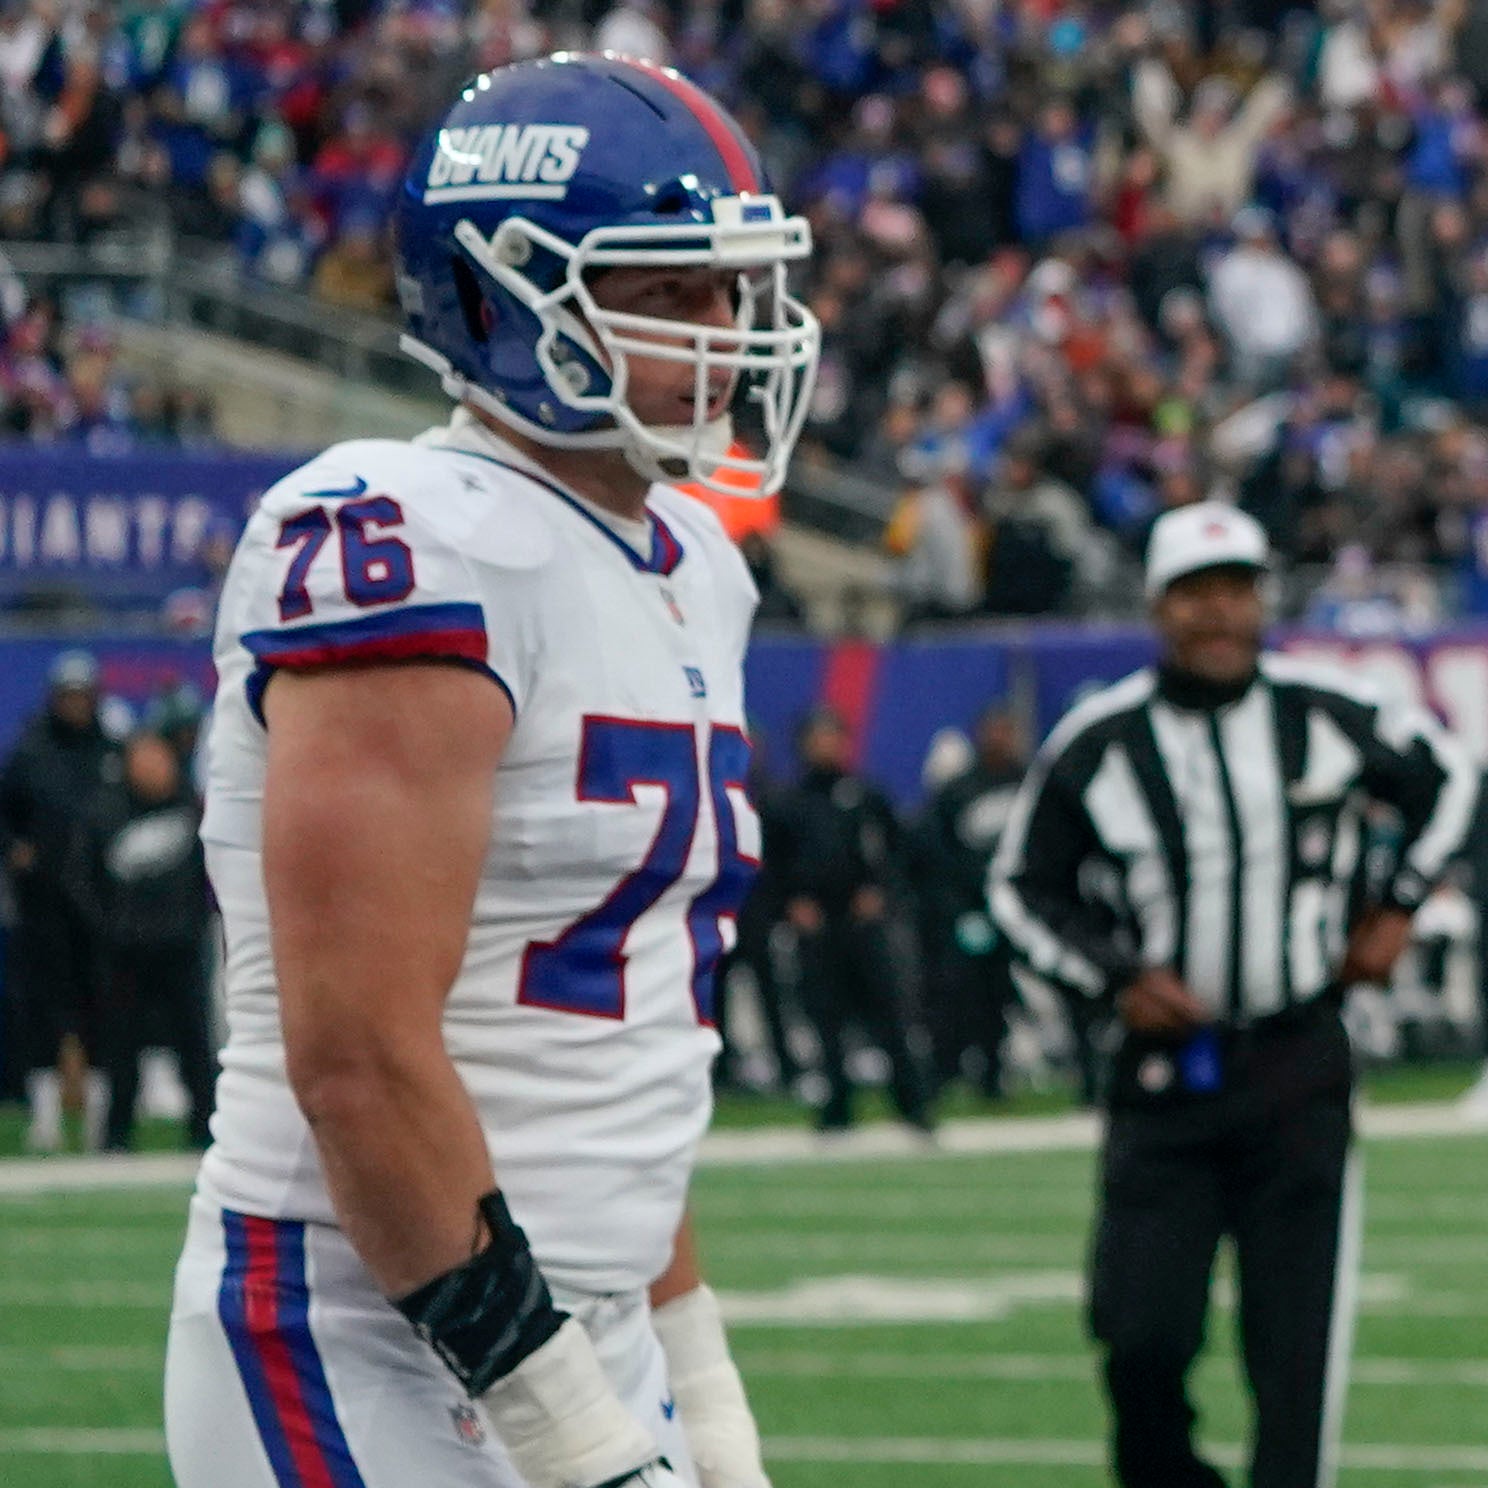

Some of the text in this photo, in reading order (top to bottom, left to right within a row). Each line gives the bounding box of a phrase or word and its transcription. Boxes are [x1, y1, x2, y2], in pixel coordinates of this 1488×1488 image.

[427, 124, 590, 187] GIANTS
[0, 494, 209, 567] IANTS
[276, 496, 415, 622] 76
